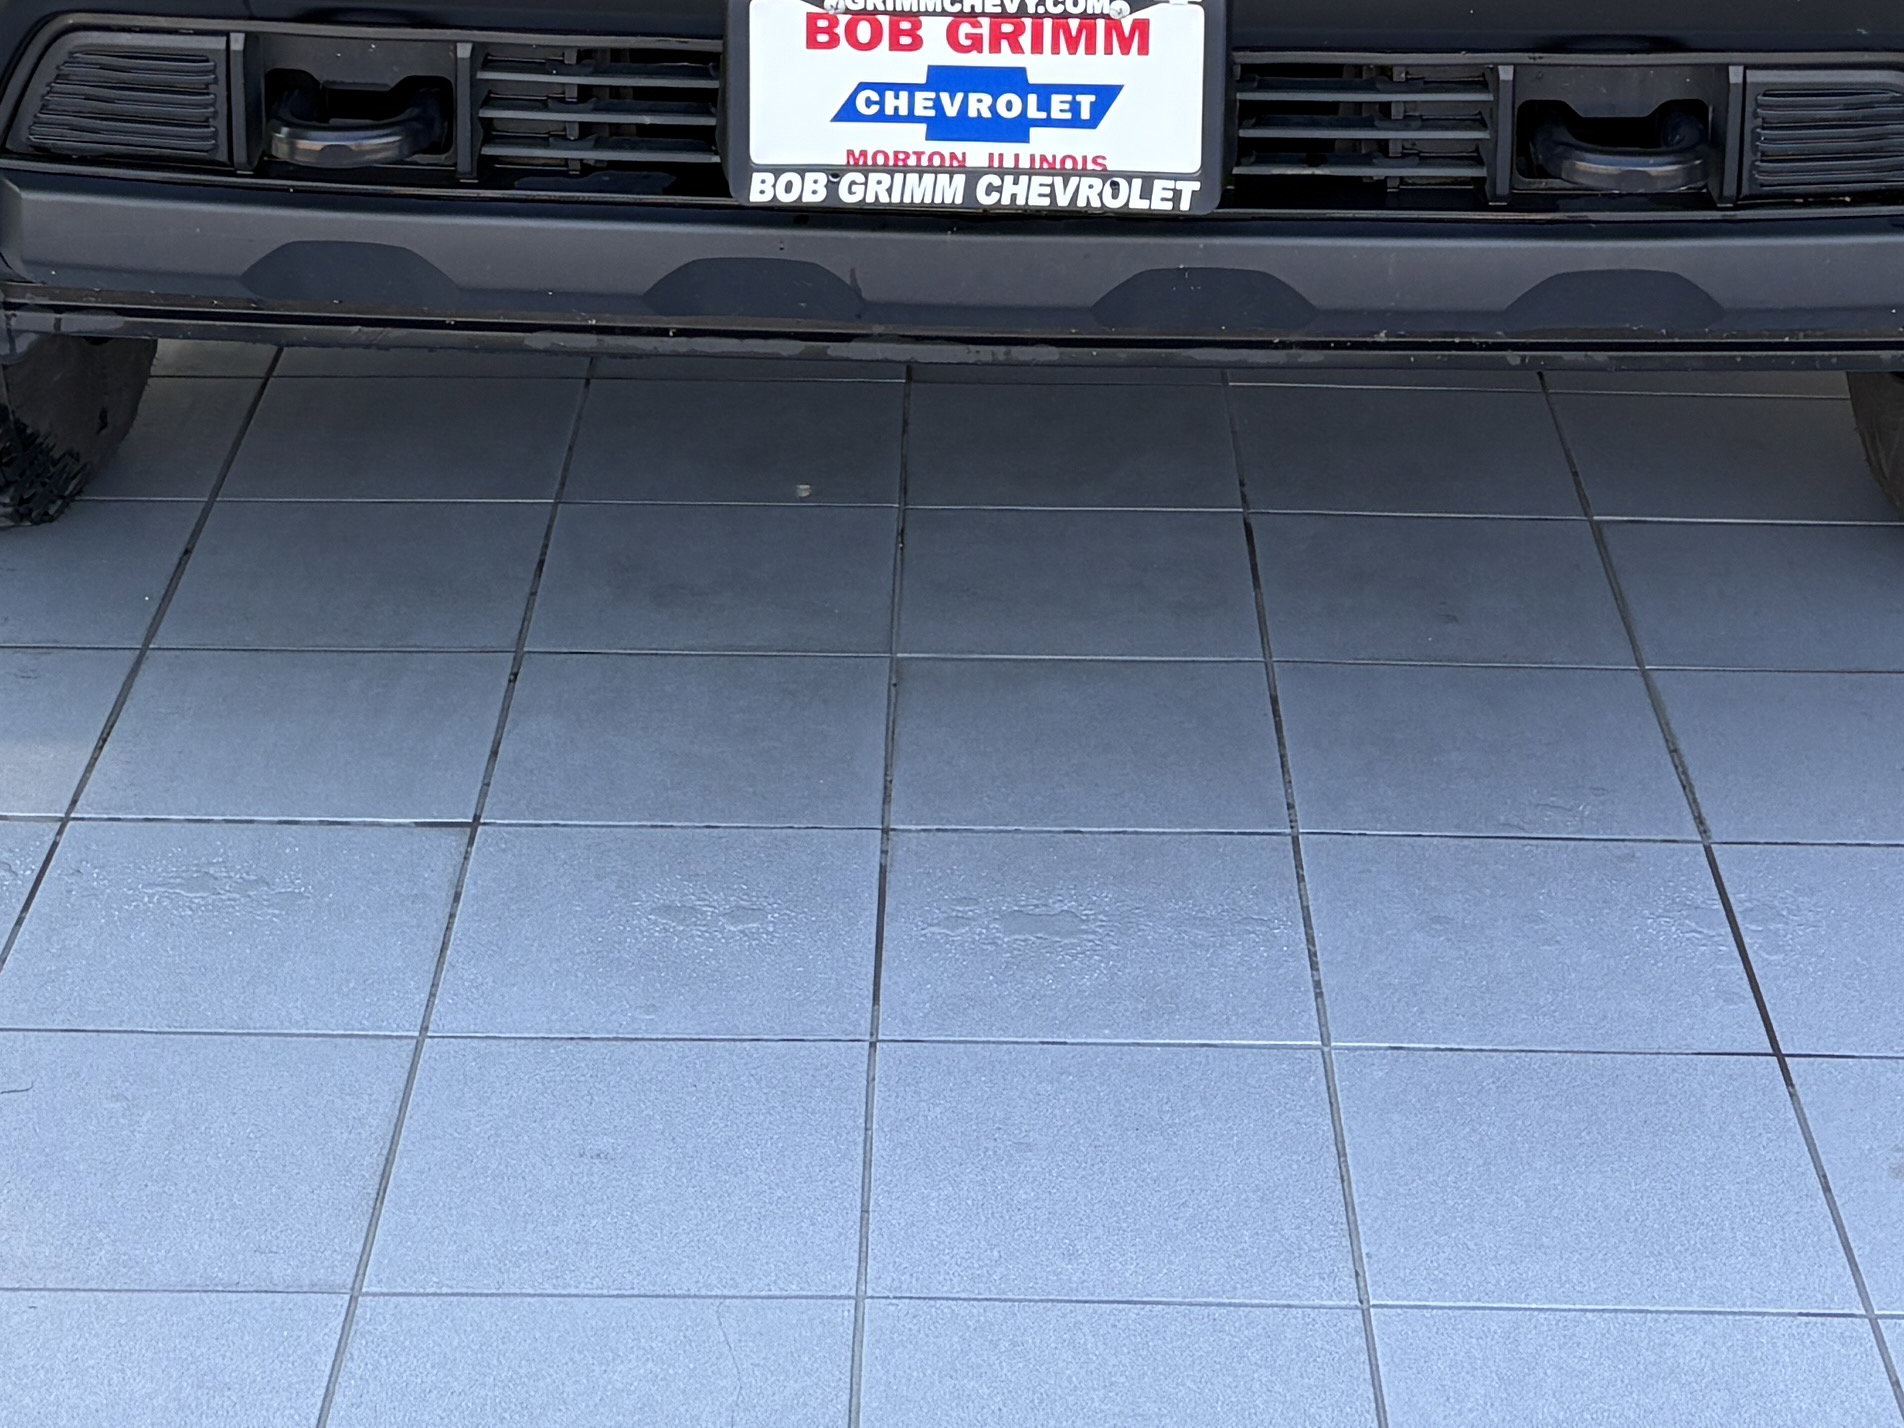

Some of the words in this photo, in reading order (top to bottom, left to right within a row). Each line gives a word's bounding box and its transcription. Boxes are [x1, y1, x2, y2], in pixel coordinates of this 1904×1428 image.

[805, 12, 925, 52] BOB
[945, 16, 1151, 56] GRIMM
[853, 88, 1097, 121] CHEVROLET
[748, 171, 828, 205] BOB
[837, 172, 967, 205] GRIMM
[975, 173, 1202, 212] CHEVROLET
